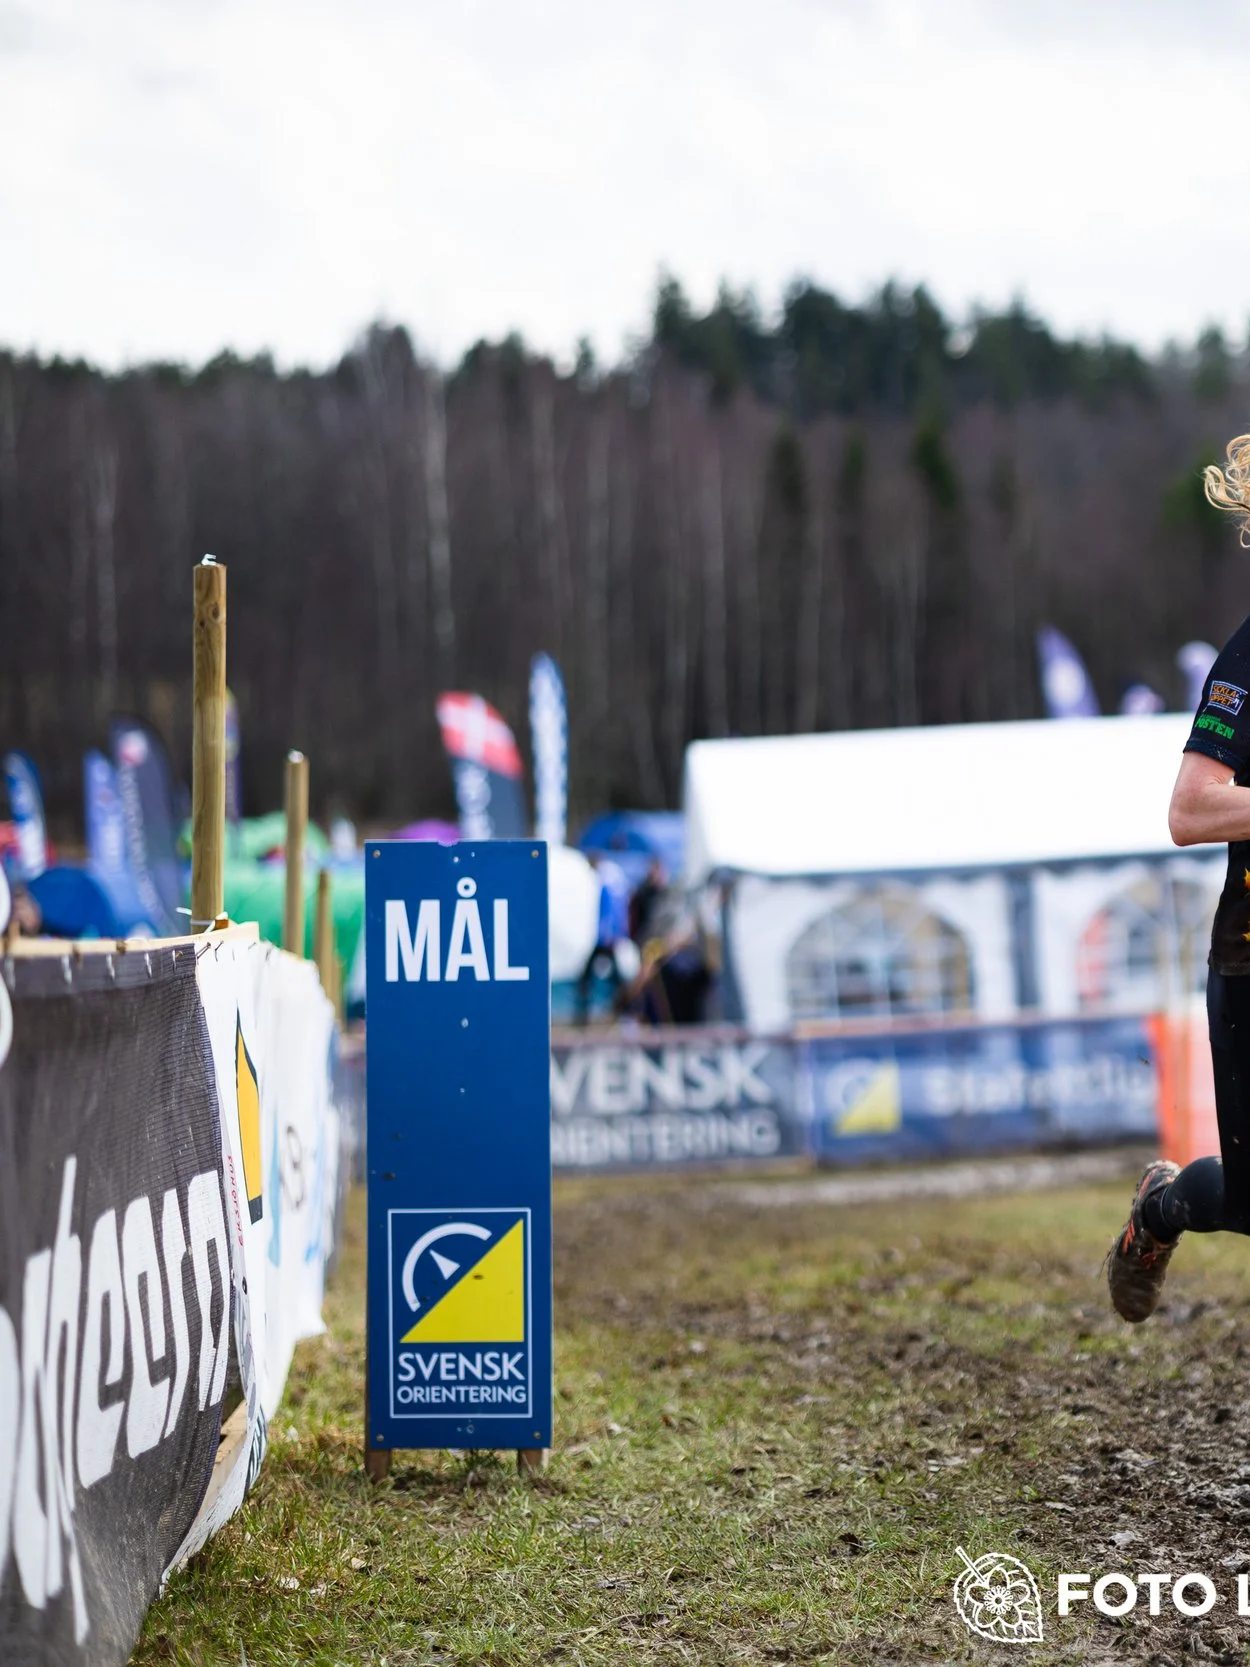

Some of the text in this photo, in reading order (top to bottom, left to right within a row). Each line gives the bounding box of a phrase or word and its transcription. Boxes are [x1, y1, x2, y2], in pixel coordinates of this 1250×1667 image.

[385, 877, 530, 982] MÅL
[549, 1040, 773, 1116] VENSK
[397, 1352, 526, 1382] SVENSK
[396, 1385, 527, 1404] ORIENTERING
